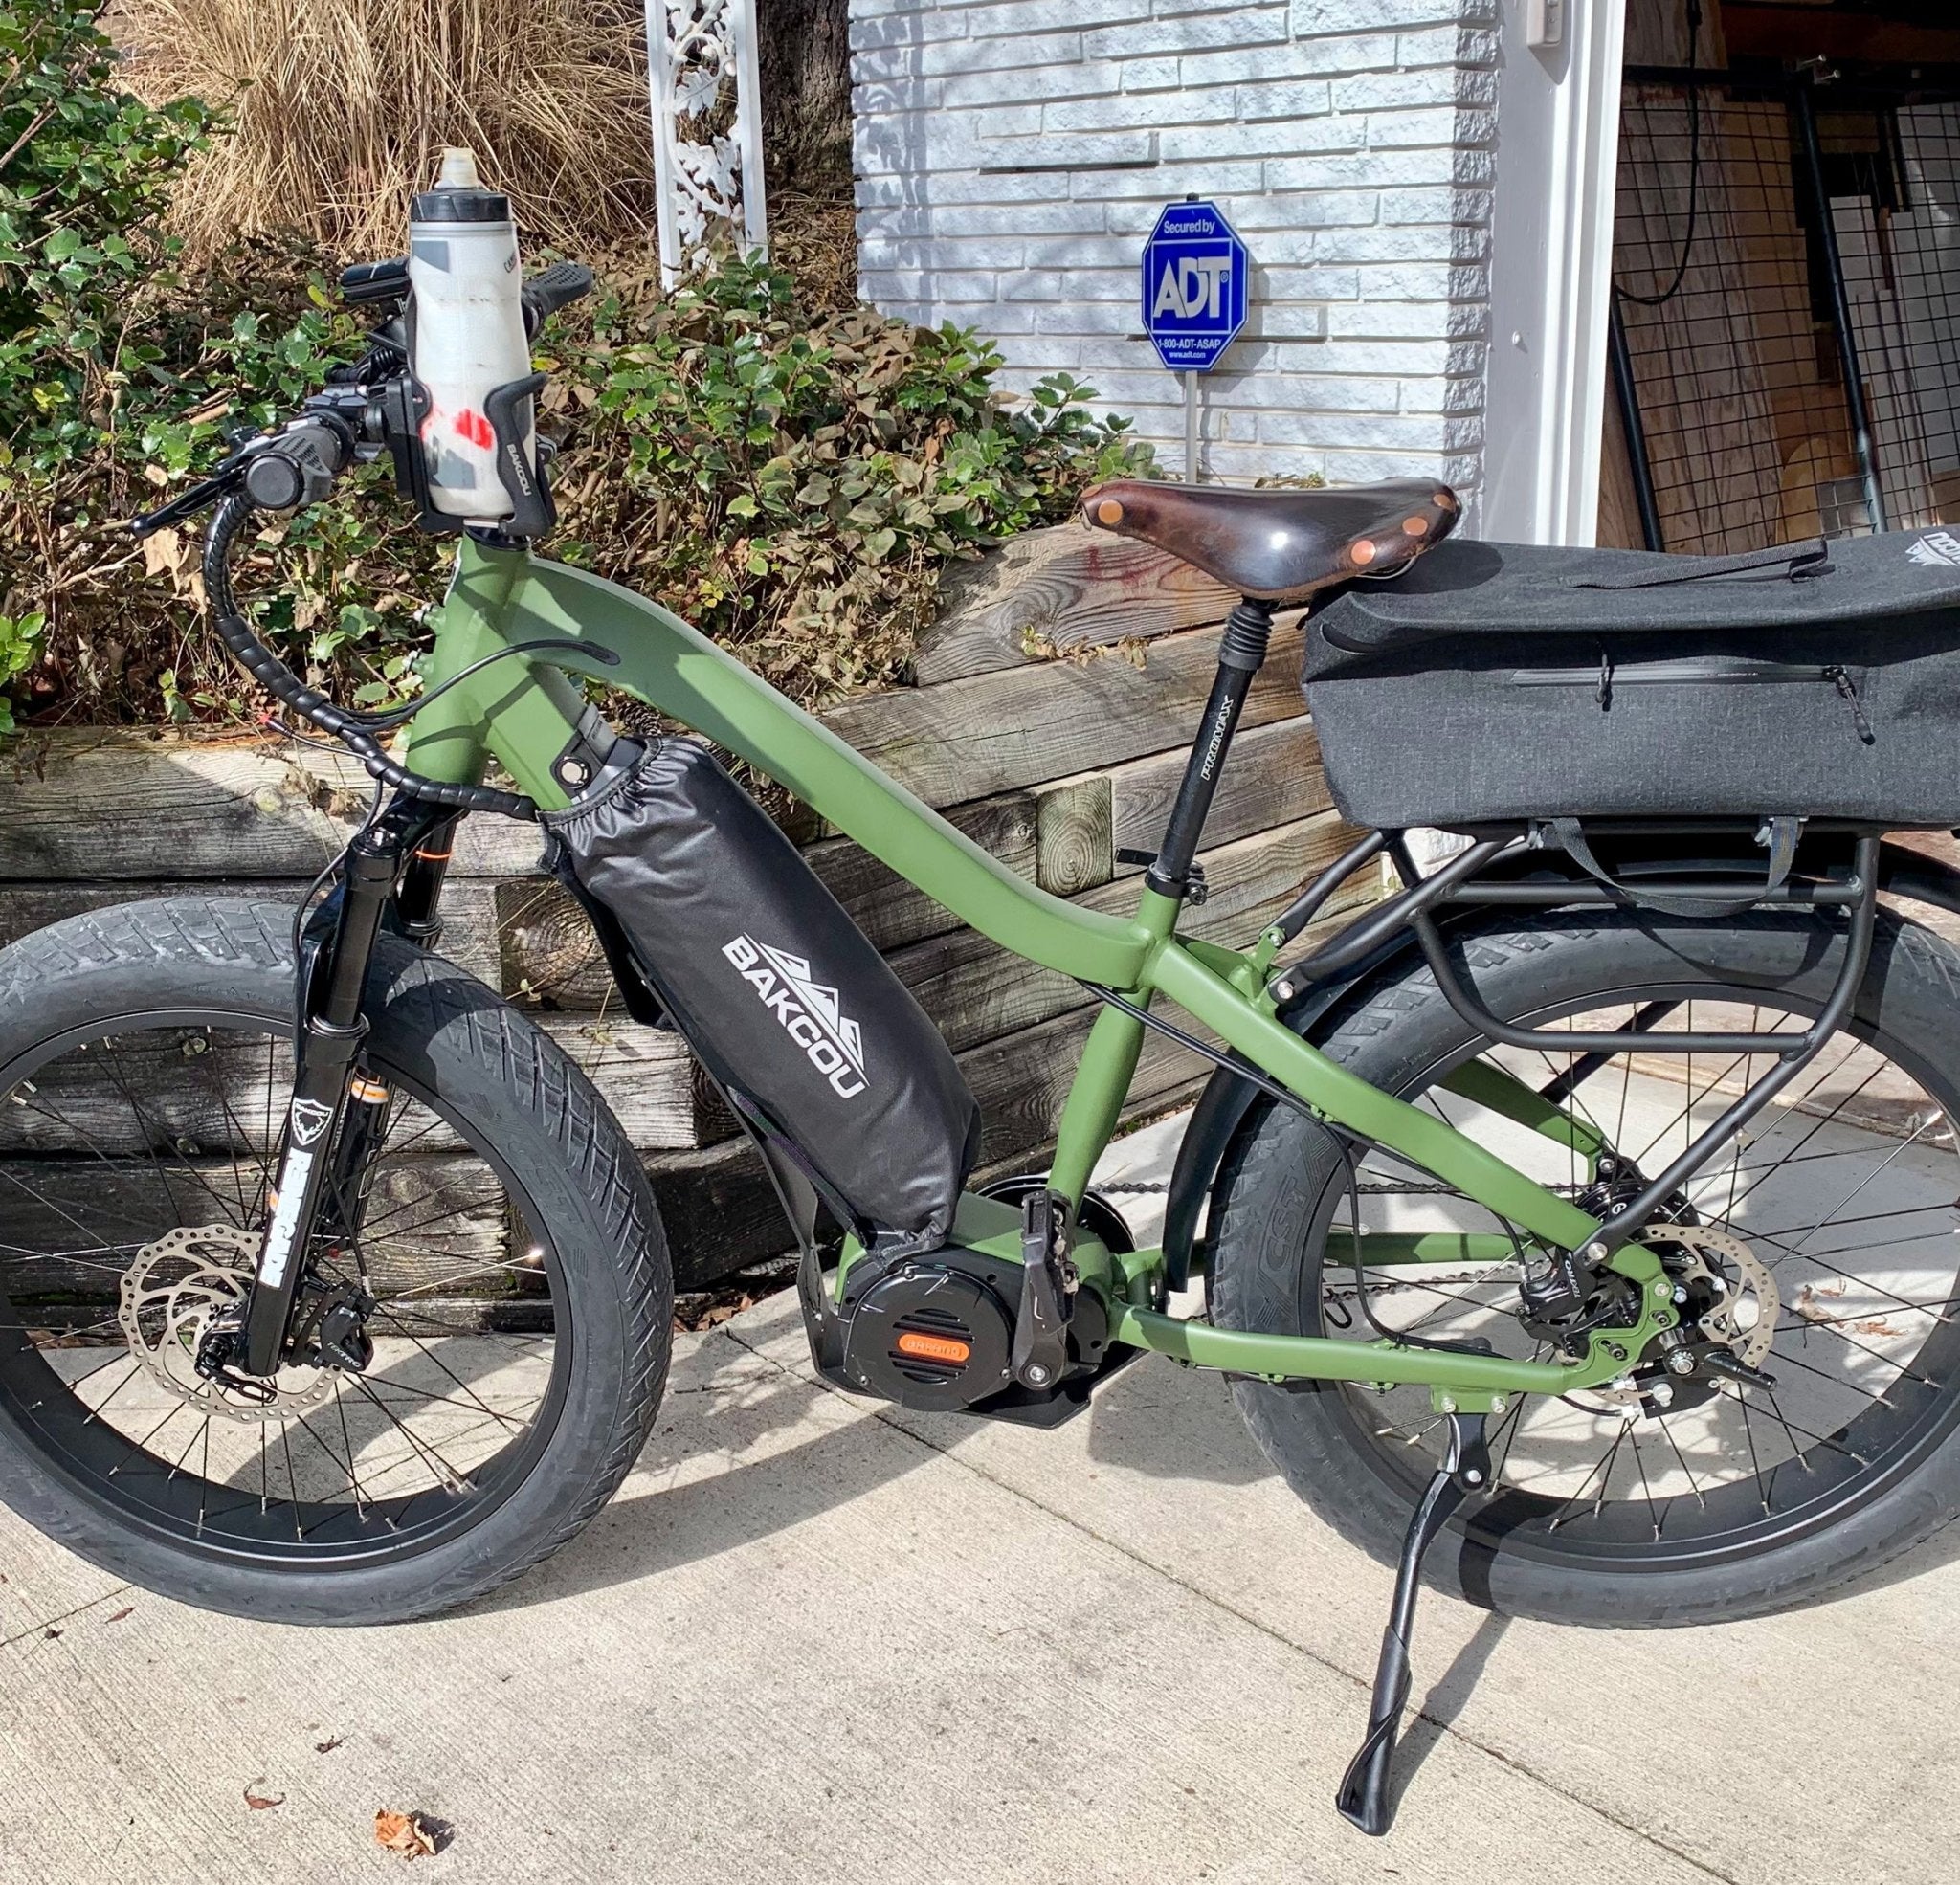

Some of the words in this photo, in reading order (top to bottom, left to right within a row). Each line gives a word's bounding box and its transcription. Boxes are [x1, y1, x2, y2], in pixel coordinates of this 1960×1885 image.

[1164, 220, 1201, 234] Secured
[1202, 220, 1215, 234] by
[1152, 256, 1230, 318] ADT
[1158, 339, 1221, 349] 1-800-ADT-ASAP
[507, 444, 532, 496] BAKCOU
[1201, 695, 1234, 781] PROMAX
[721, 935, 866, 1099] BAKCOU
[295, 1103, 329, 1118] BAKCOU
[1266, 1177, 1308, 1272] CST
[1565, 1259, 1581, 1298] TEKTRO
[327, 1342, 361, 1368] TEKTRO
